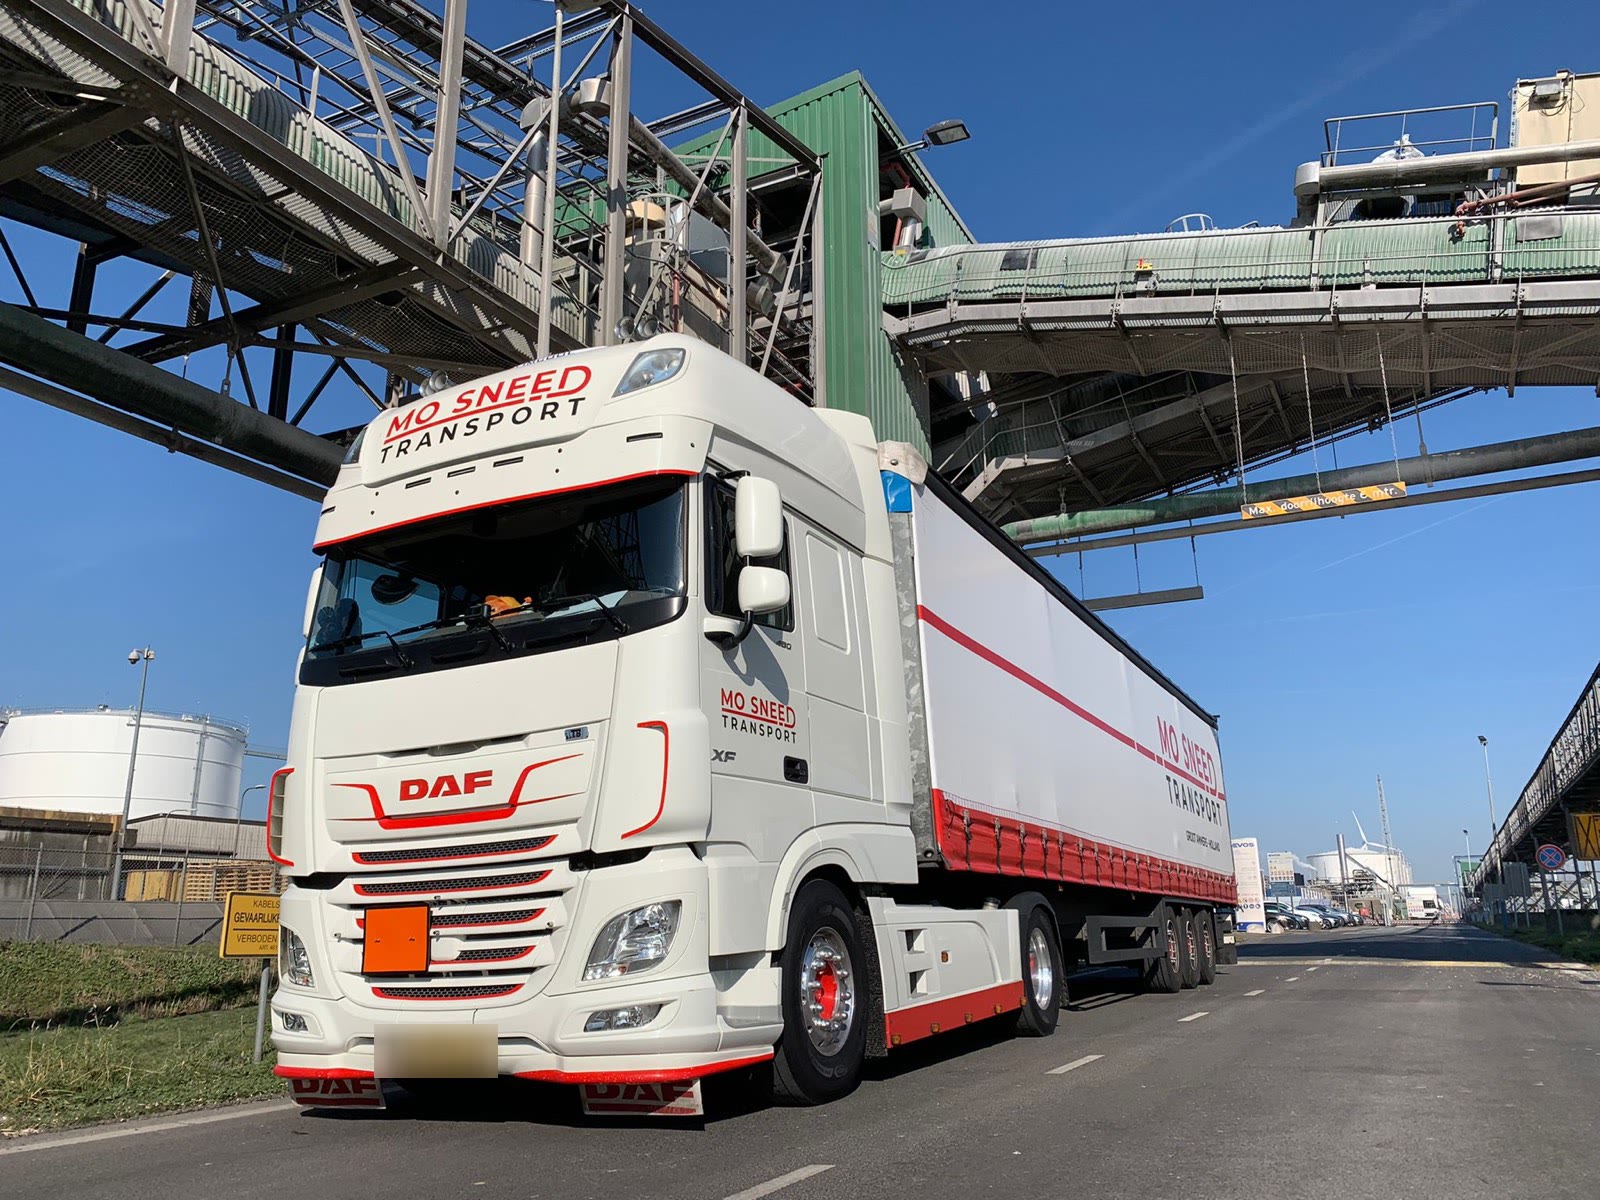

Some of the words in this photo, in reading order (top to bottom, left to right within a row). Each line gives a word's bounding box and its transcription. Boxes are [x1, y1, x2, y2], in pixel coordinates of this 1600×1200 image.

[386, 401, 440, 437] MO
[452, 365, 592, 414] SNEED
[381, 397, 586, 464] TRANSPORT
[720, 687, 745, 710] MO
[751, 696, 796, 729] SNEED
[722, 714, 797, 744] TRANSPORT
[711, 749, 736, 763] XF
[1157, 716, 1179, 763] MO
[1182, 733, 1217, 797] SNEED
[399, 769, 493, 801] DAF
[1166, 774, 1222, 826] TRANSPORT
[253, 900, 280, 908] KABELS
[237, 934, 277, 943] VERBODEN
[292, 1079, 377, 1094] DAF
[584, 1080, 695, 1102] DAF
